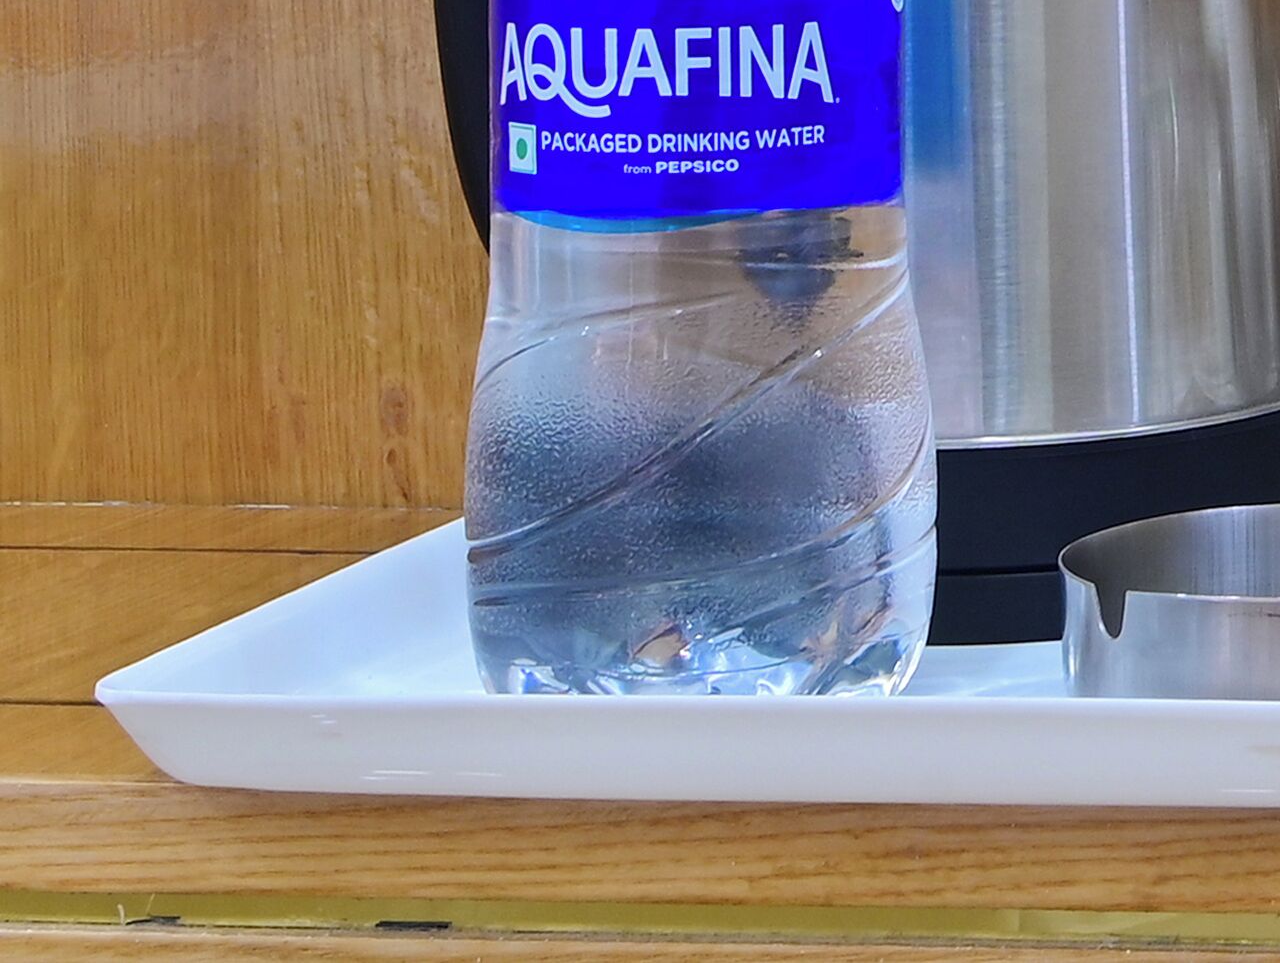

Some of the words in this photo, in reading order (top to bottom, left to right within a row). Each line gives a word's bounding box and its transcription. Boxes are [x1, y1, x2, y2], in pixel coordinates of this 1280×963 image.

[500, 21, 835, 119] AQUAFINA
[541, 131, 642, 153] PACKAGED
[648, 130, 749, 153] DRINKING
[755, 125, 825, 148] WATER
[623, 164, 652, 174] from
[656, 159, 739, 174] PEPSICO
